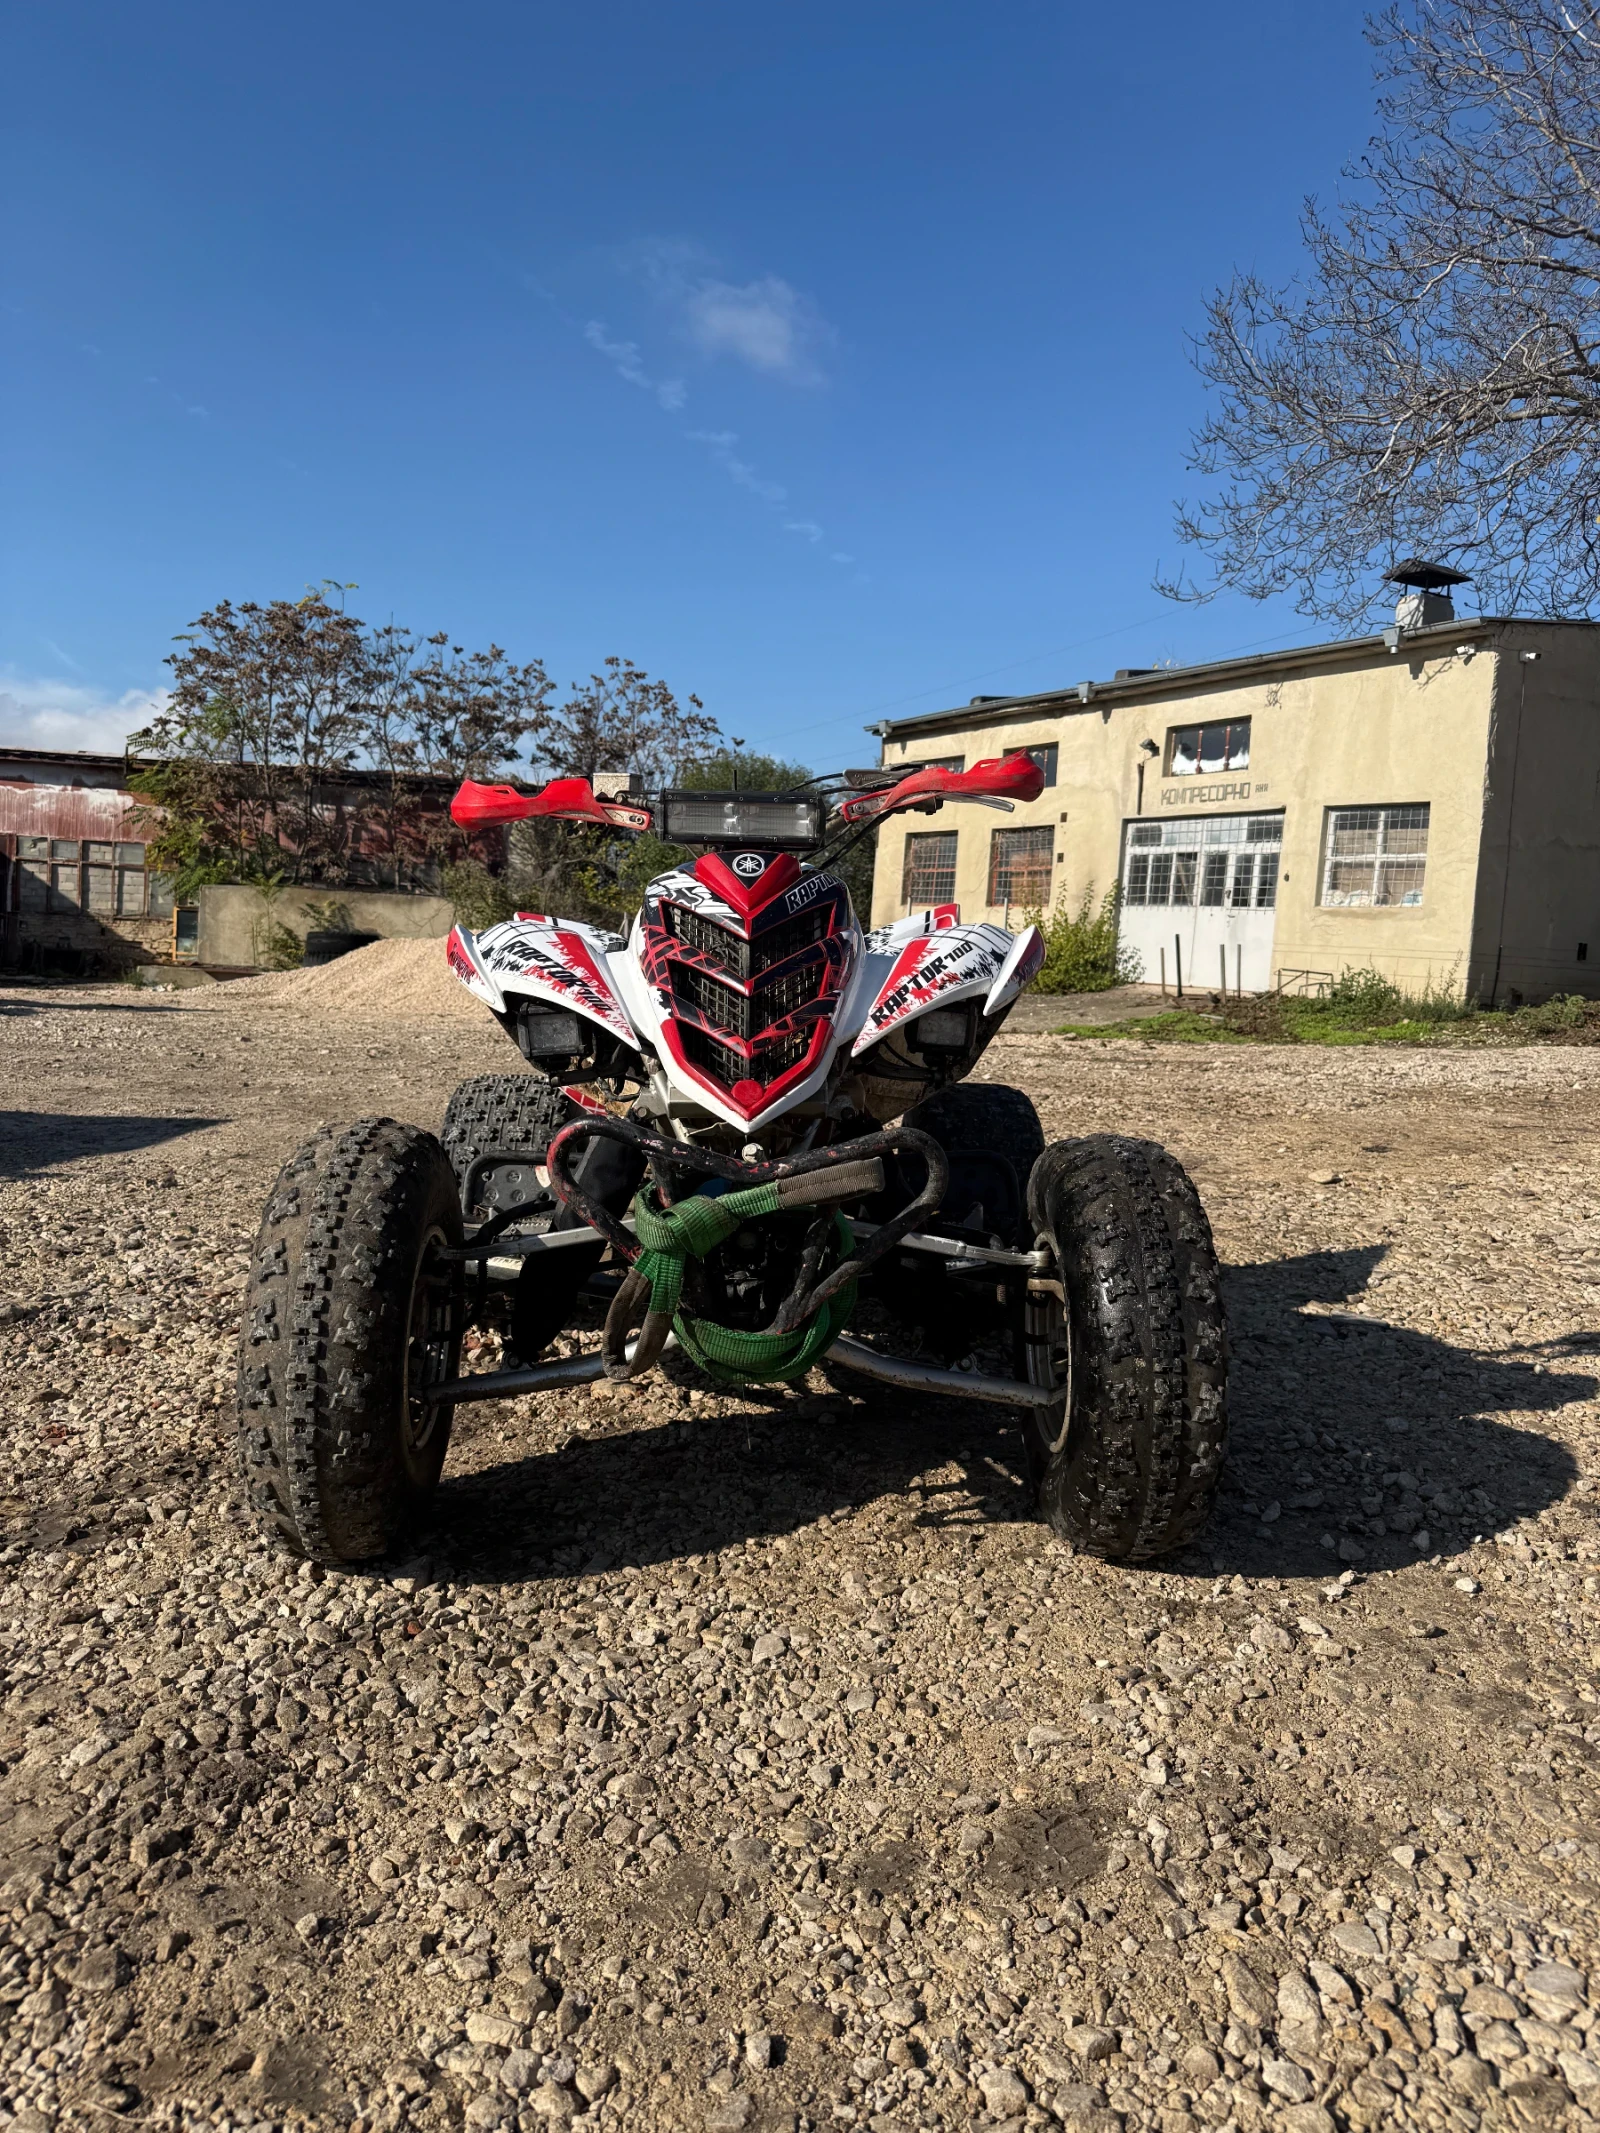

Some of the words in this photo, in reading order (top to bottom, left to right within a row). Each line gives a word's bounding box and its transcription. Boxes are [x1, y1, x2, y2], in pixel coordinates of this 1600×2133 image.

[1160, 782, 1251, 805] КОМПРЕСОРНО
[503, 940, 588, 989] RAPTOR
[870, 957, 947, 1026] RAPTOR
[943, 942, 974, 963] 700
